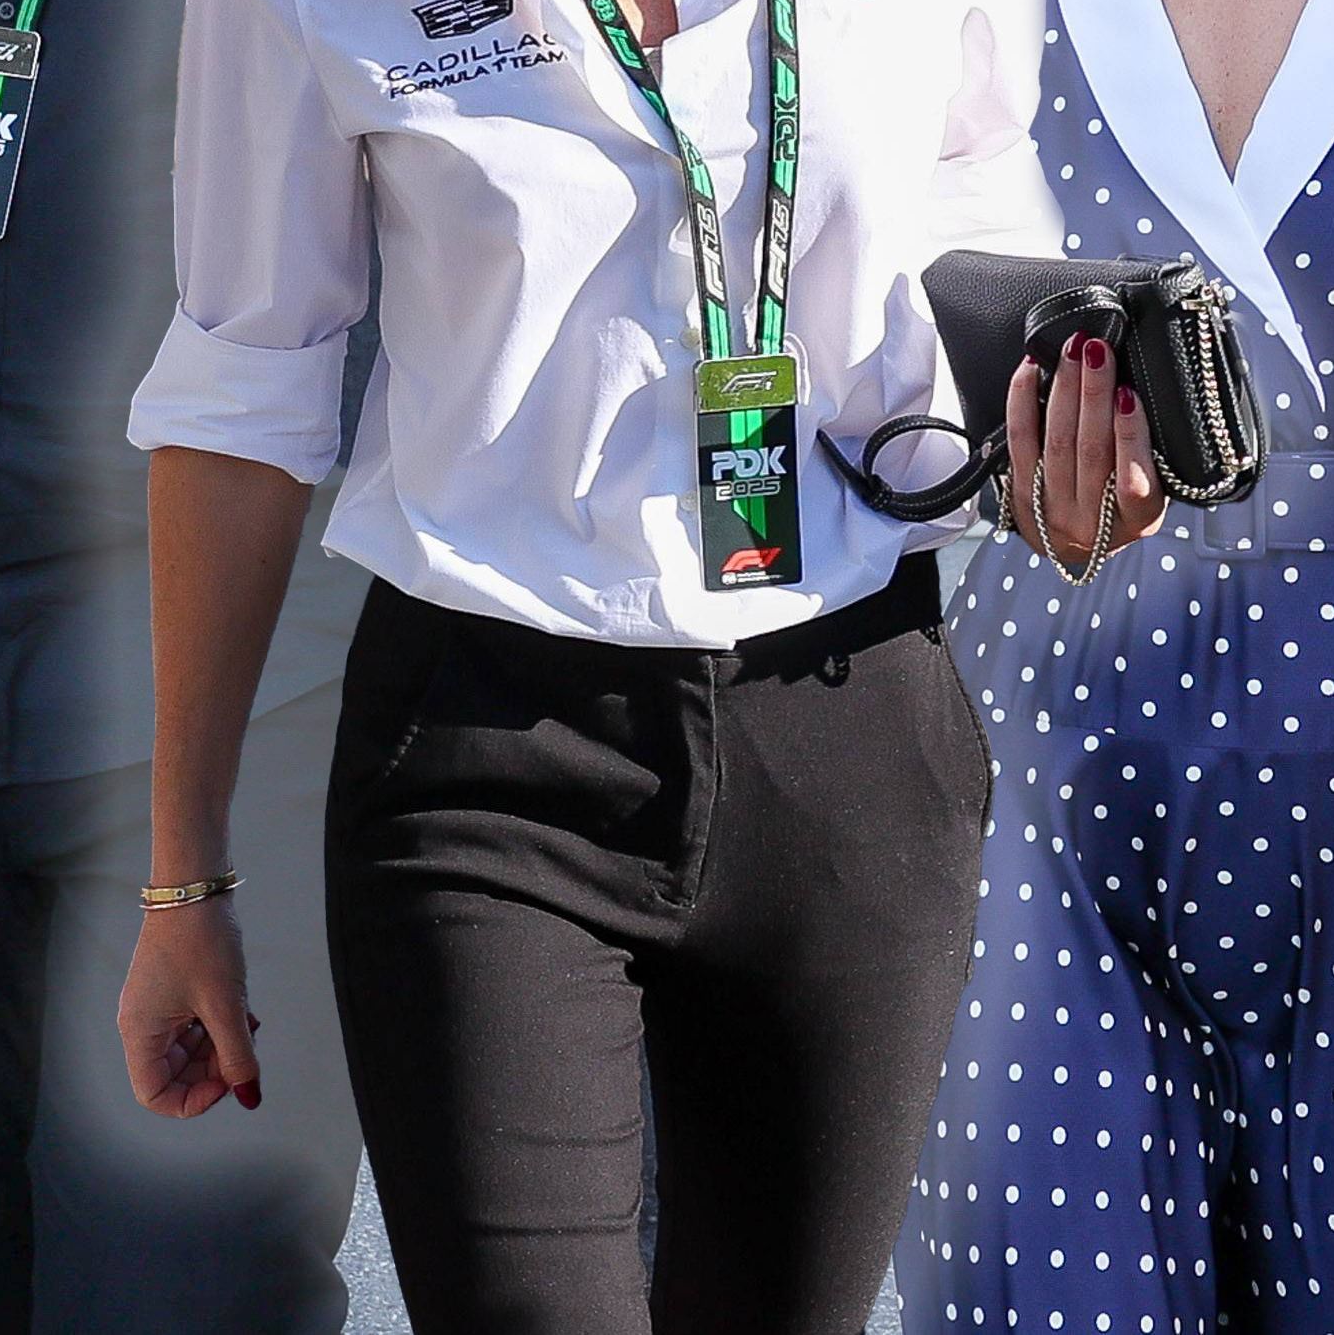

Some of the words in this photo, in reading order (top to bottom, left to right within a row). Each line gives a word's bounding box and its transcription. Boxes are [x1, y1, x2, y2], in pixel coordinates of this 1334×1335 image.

[390, 67, 491, 99] FORMULA
[774, 93, 798, 162] PDK
[712, 445, 786, 480] PDK
[715, 477, 781, 501] 2025
[721, 547, 781, 571] F1
